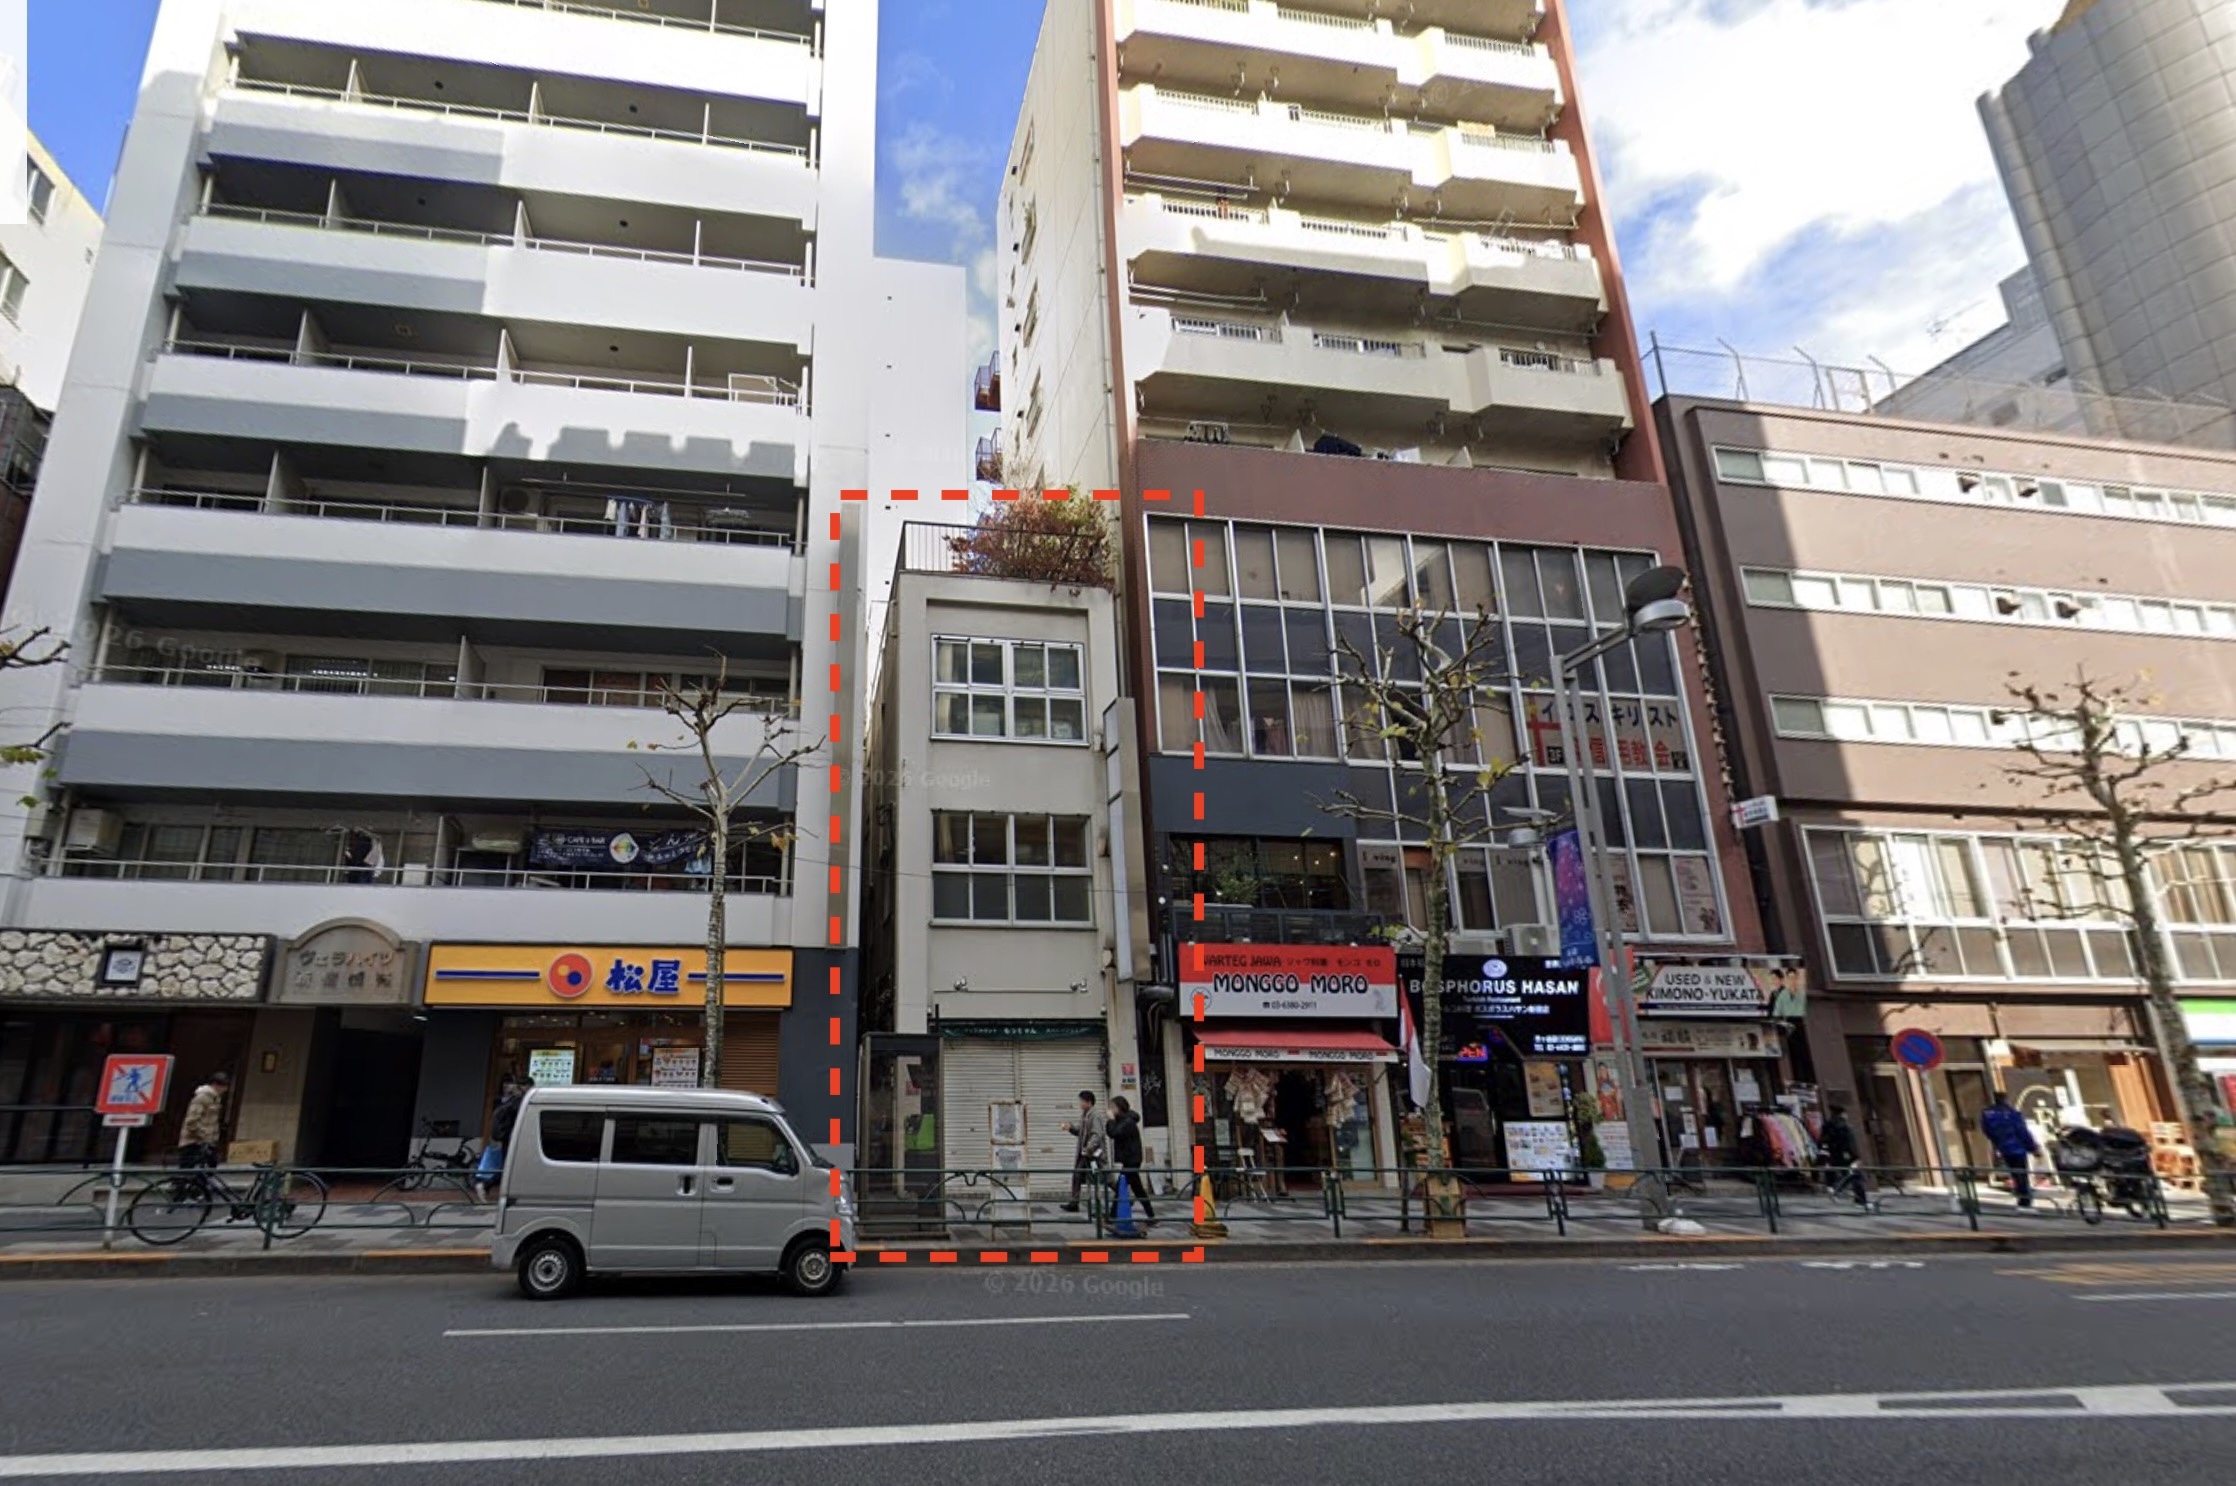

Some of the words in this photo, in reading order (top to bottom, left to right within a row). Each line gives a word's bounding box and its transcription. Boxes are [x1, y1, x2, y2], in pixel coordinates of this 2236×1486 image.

[1541, 700, 1600, 724] イス
[299, 950, 394, 968] ヴェラハイツ
[1250, 955, 1282, 967] JAWA
[605, 958, 682, 994] 松屋
[1213, 972, 1299, 994] MONGGO
[1310, 973, 1369, 994] MORO
[1665, 974, 1700, 986] USED
[1715, 975, 1745, 987] NEW
[1409, 979, 1516, 995] BSPHORUS
[1521, 980, 1580, 996] HASAN
[1213, 1048, 1252, 1058] MONGGO
[1255, 1049, 1281, 1059] MORO
[1309, 1050, 1346, 1060] MONGGO
[1349, 1051, 1375, 1061] MORO
